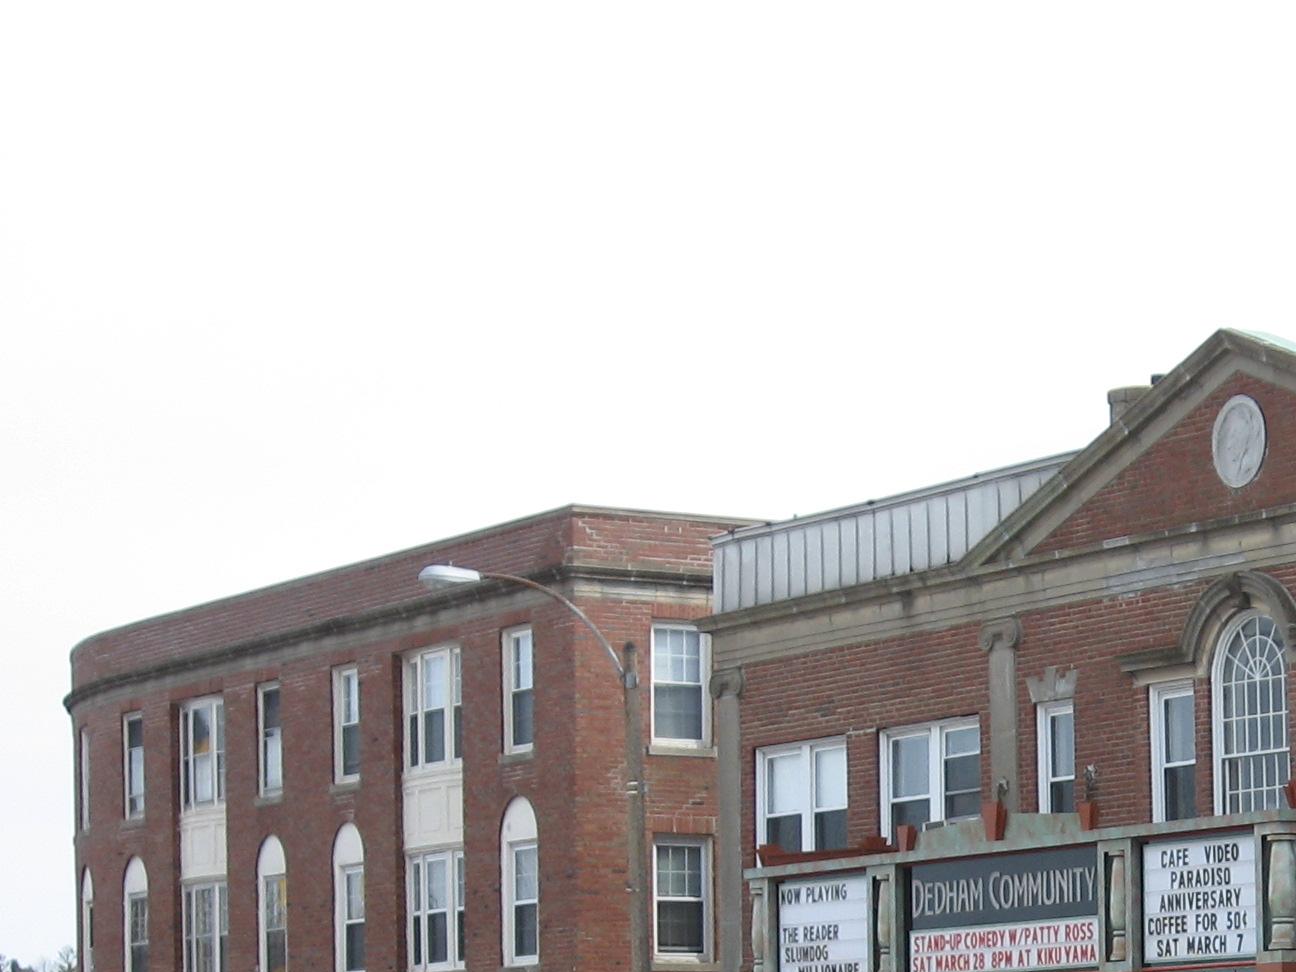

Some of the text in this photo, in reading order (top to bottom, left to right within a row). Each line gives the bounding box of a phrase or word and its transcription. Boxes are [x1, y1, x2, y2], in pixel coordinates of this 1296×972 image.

[1161, 843, 1239, 868] CAFE VIDEO
[1170, 867, 1231, 889] PARADISO
[781, 883, 847, 905] NOW PLAYING
[912, 865, 1096, 919] DEDHAM COMMUNITY
[1159, 888, 1241, 912] ANNIVERSARY
[783, 924, 839, 943] THE READER
[1148, 915, 1187, 935] COFFEE
[1195, 913, 1218, 932] FOR
[914, 922, 1094, 954] STAND-UP COMEDY W/PATTY ROSS
[1157, 934, 1244, 957] SAT MARCH 7
[785, 945, 828, 963] SLUMDOG
[935, 954, 970, 972] MARCH
[973, 953, 985, 970] 28
[991, 950, 1013, 968] 8PM
[1018, 949, 1031, 966] AT
[1037, 946, 1062, 965] KIKU
[1064, 944, 1097, 962] YAMA
